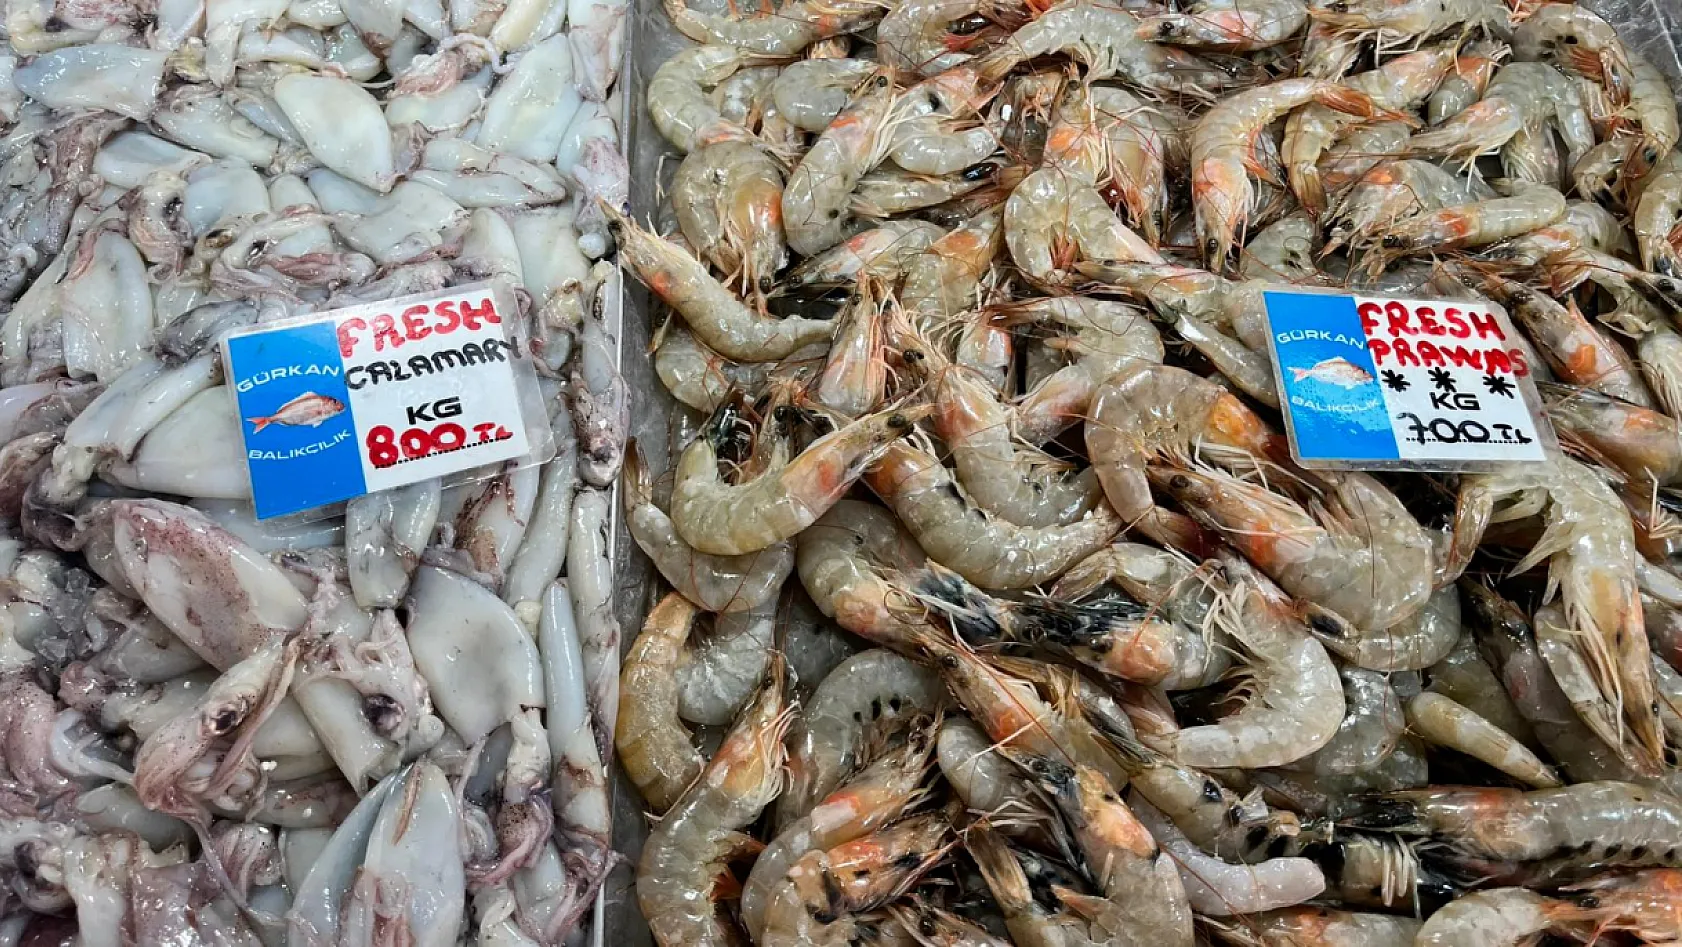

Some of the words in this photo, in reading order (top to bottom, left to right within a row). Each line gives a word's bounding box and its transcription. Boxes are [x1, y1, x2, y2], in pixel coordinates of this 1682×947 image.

[337, 298, 501, 357] FRESH
[1357, 301, 1506, 341] FRESH
[1276, 329, 1366, 350] GÜRKAN
[236, 364, 341, 393] GÜRKAN
[344, 336, 522, 389] CALAMARY
[406, 397, 463, 424] KG
[1429, 392, 1481, 411] KG
[366, 423, 466, 467] 800
[1396, 412, 1490, 446] 700
